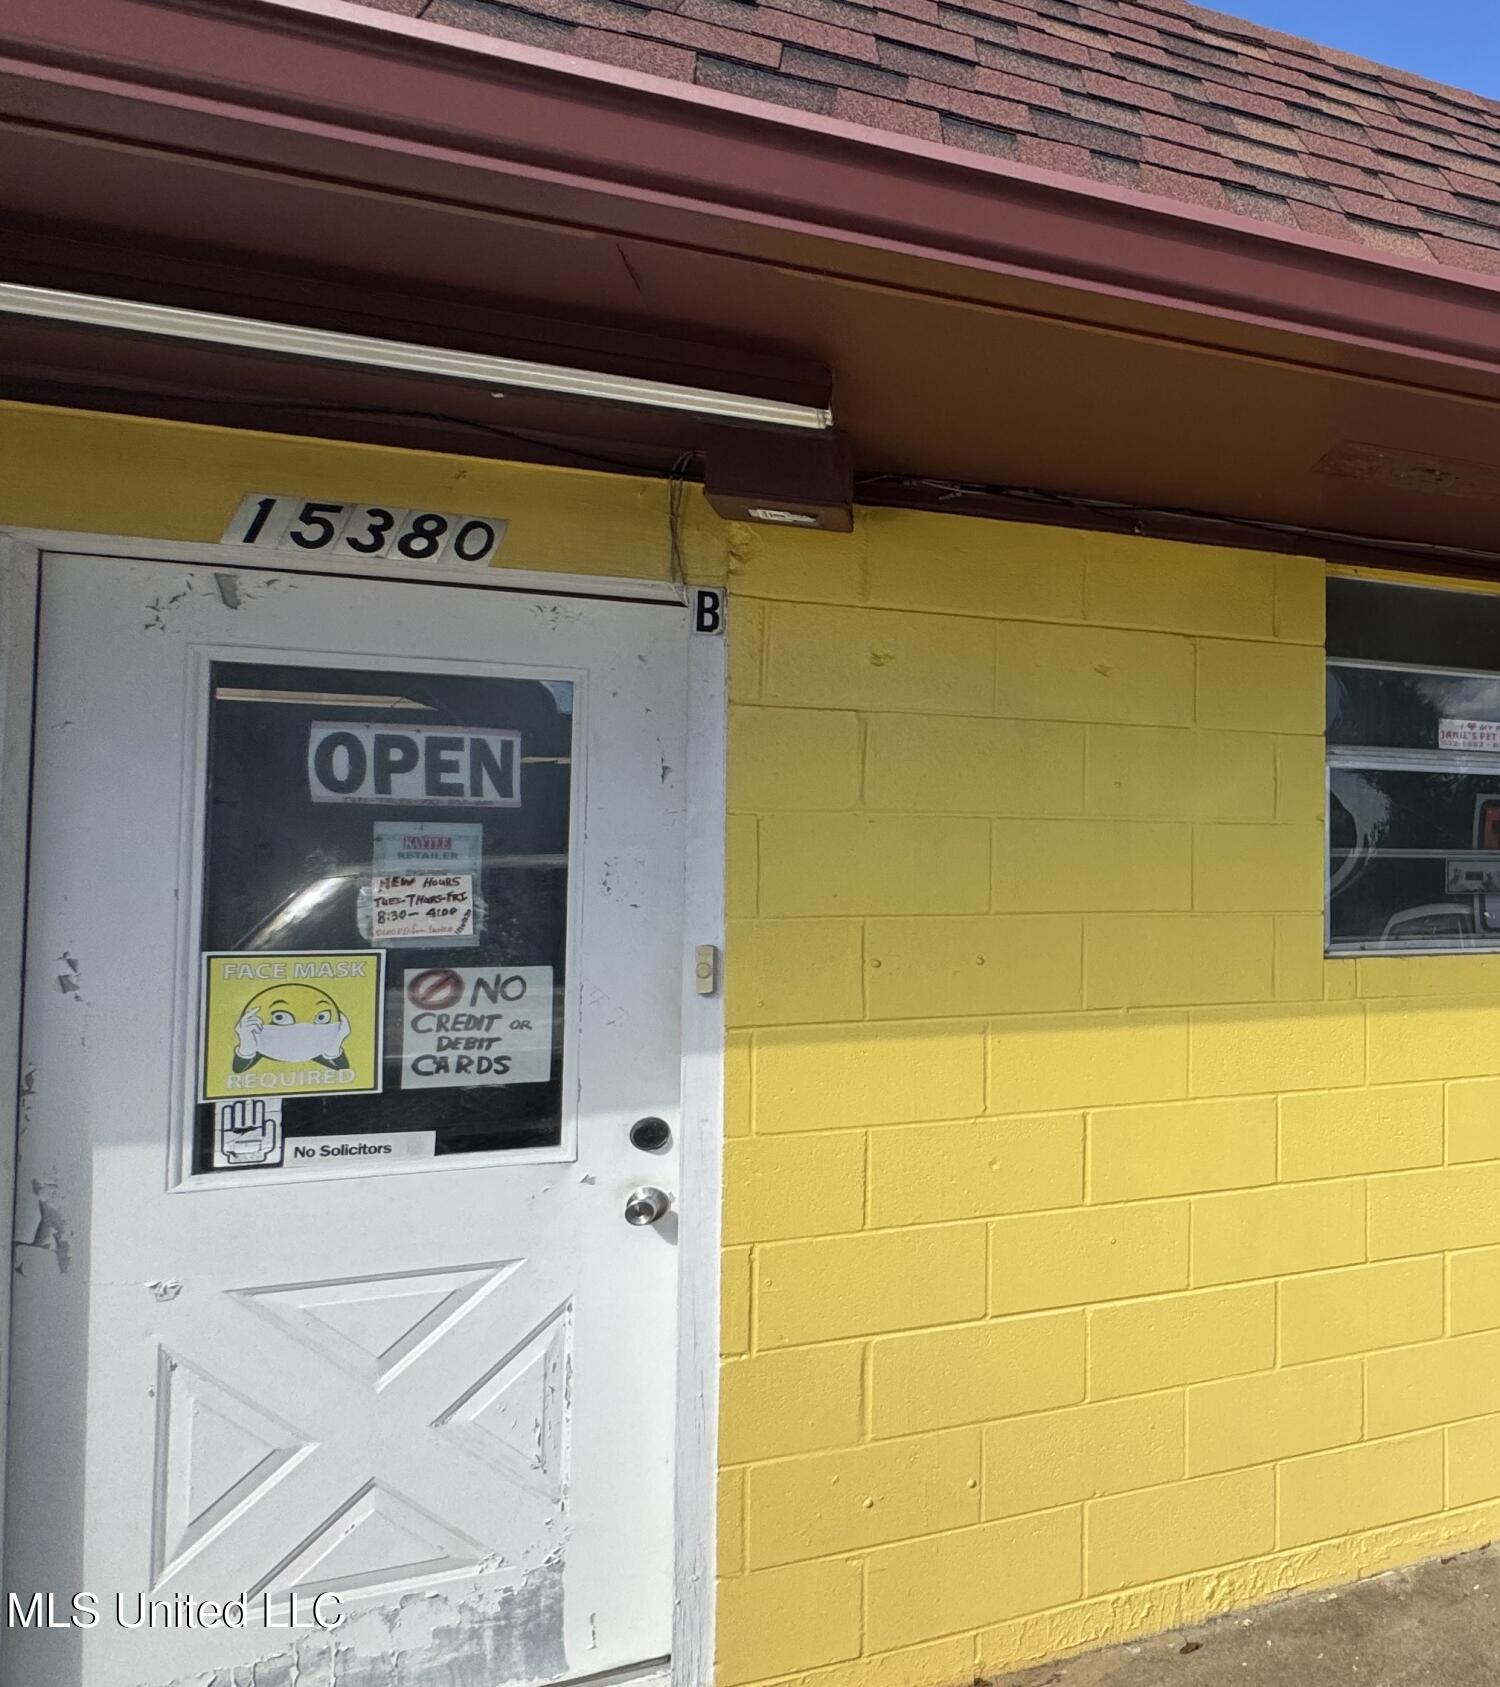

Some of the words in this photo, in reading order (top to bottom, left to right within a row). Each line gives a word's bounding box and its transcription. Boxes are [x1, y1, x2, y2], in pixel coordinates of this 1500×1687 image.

[243, 498, 496, 560] 15380
[698, 591, 720, 632] B
[1480, 732, 1497, 741] PET
[314, 731, 514, 798] OPEN
[397, 851, 459, 860] RETAILER
[379, 876, 416, 889] NEW
[423, 877, 462, 888] HOURS
[425, 907, 458, 918] 4:00
[222, 963, 289, 980] FACE
[294, 961, 367, 979] MASK
[471, 975, 527, 1006] NO
[410, 1013, 503, 1034] CREDIT
[509, 1018, 533, 1031] OR
[436, 1036, 502, 1052] DEBIT
[411, 1054, 513, 1076] CARDS
[226, 1068, 356, 1090] REQUIRED
[294, 1146, 315, 1158] No
[320, 1143, 392, 1158] Solicitors
